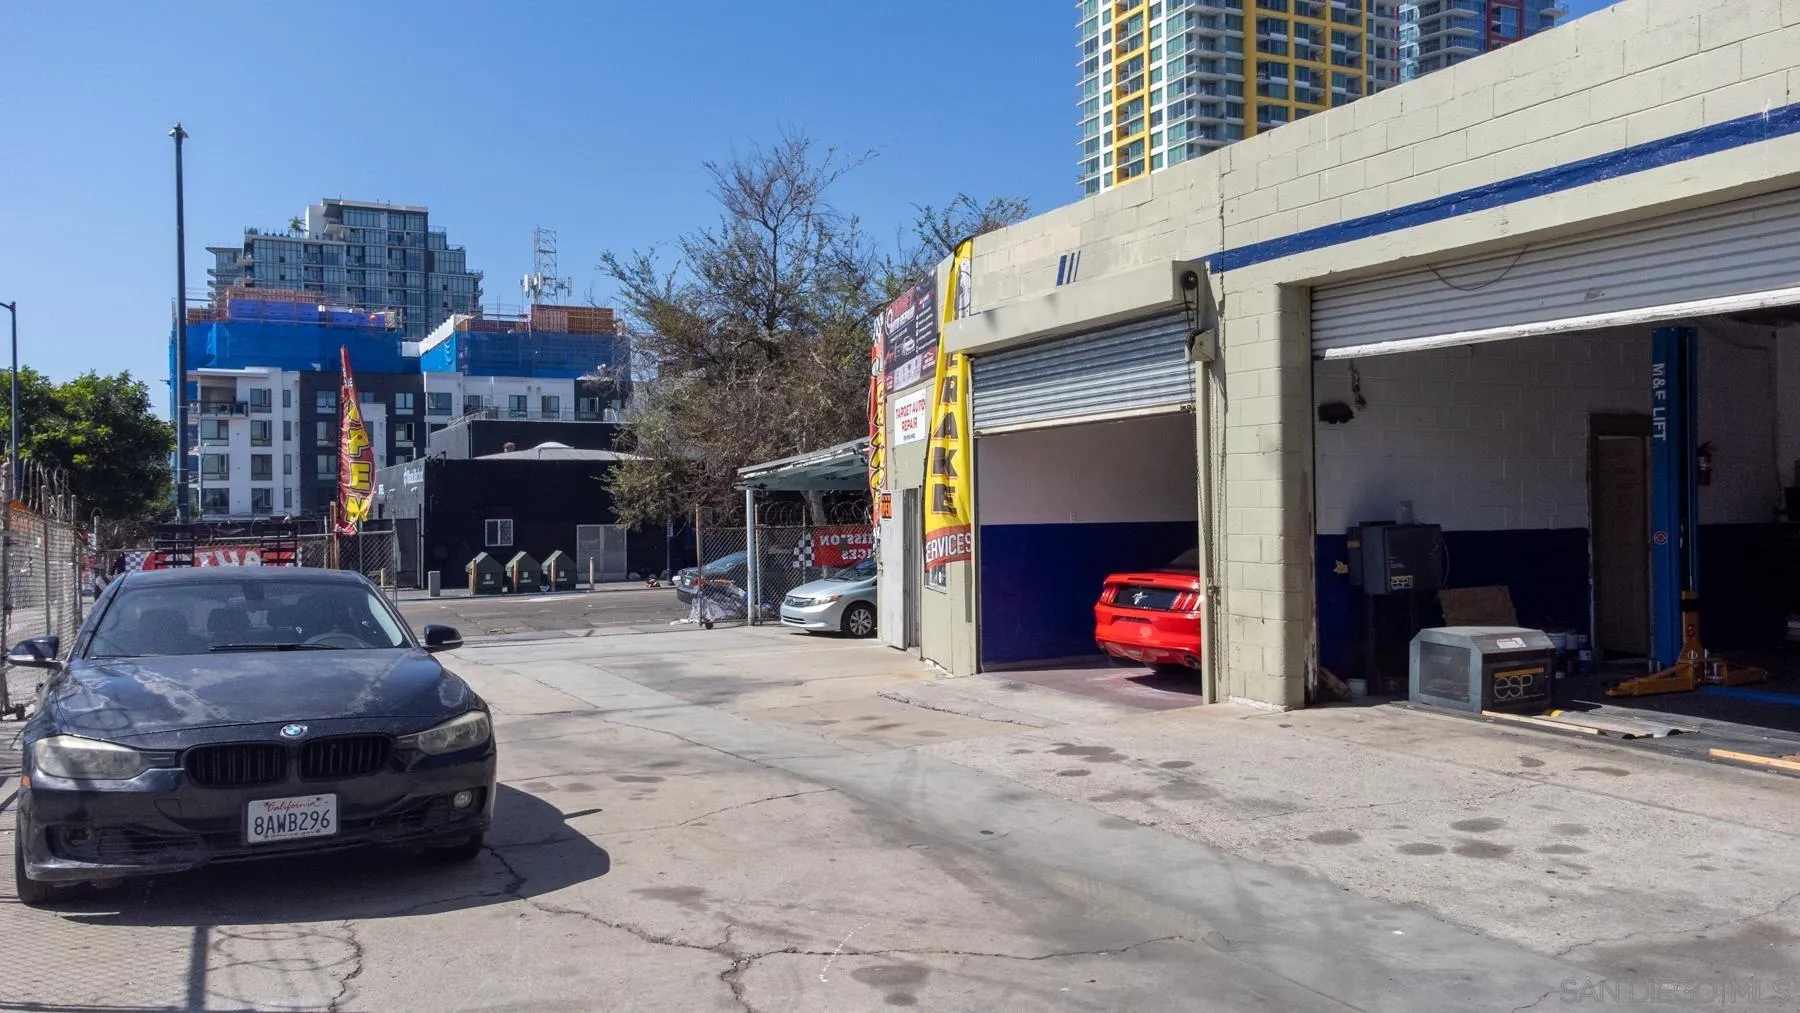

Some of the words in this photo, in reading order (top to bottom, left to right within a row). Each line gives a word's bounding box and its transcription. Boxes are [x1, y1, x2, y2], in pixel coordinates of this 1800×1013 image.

[895, 404, 912, 420] TARGET
[912, 398, 926, 413] AUTO
[901, 416, 918, 432] REPAIR
[1652, 406, 1667, 441] LIFT
[925, 532, 972, 563] ERVICES
[267, 800, 319, 813] California
[254, 809, 331, 836] 8AWB296
